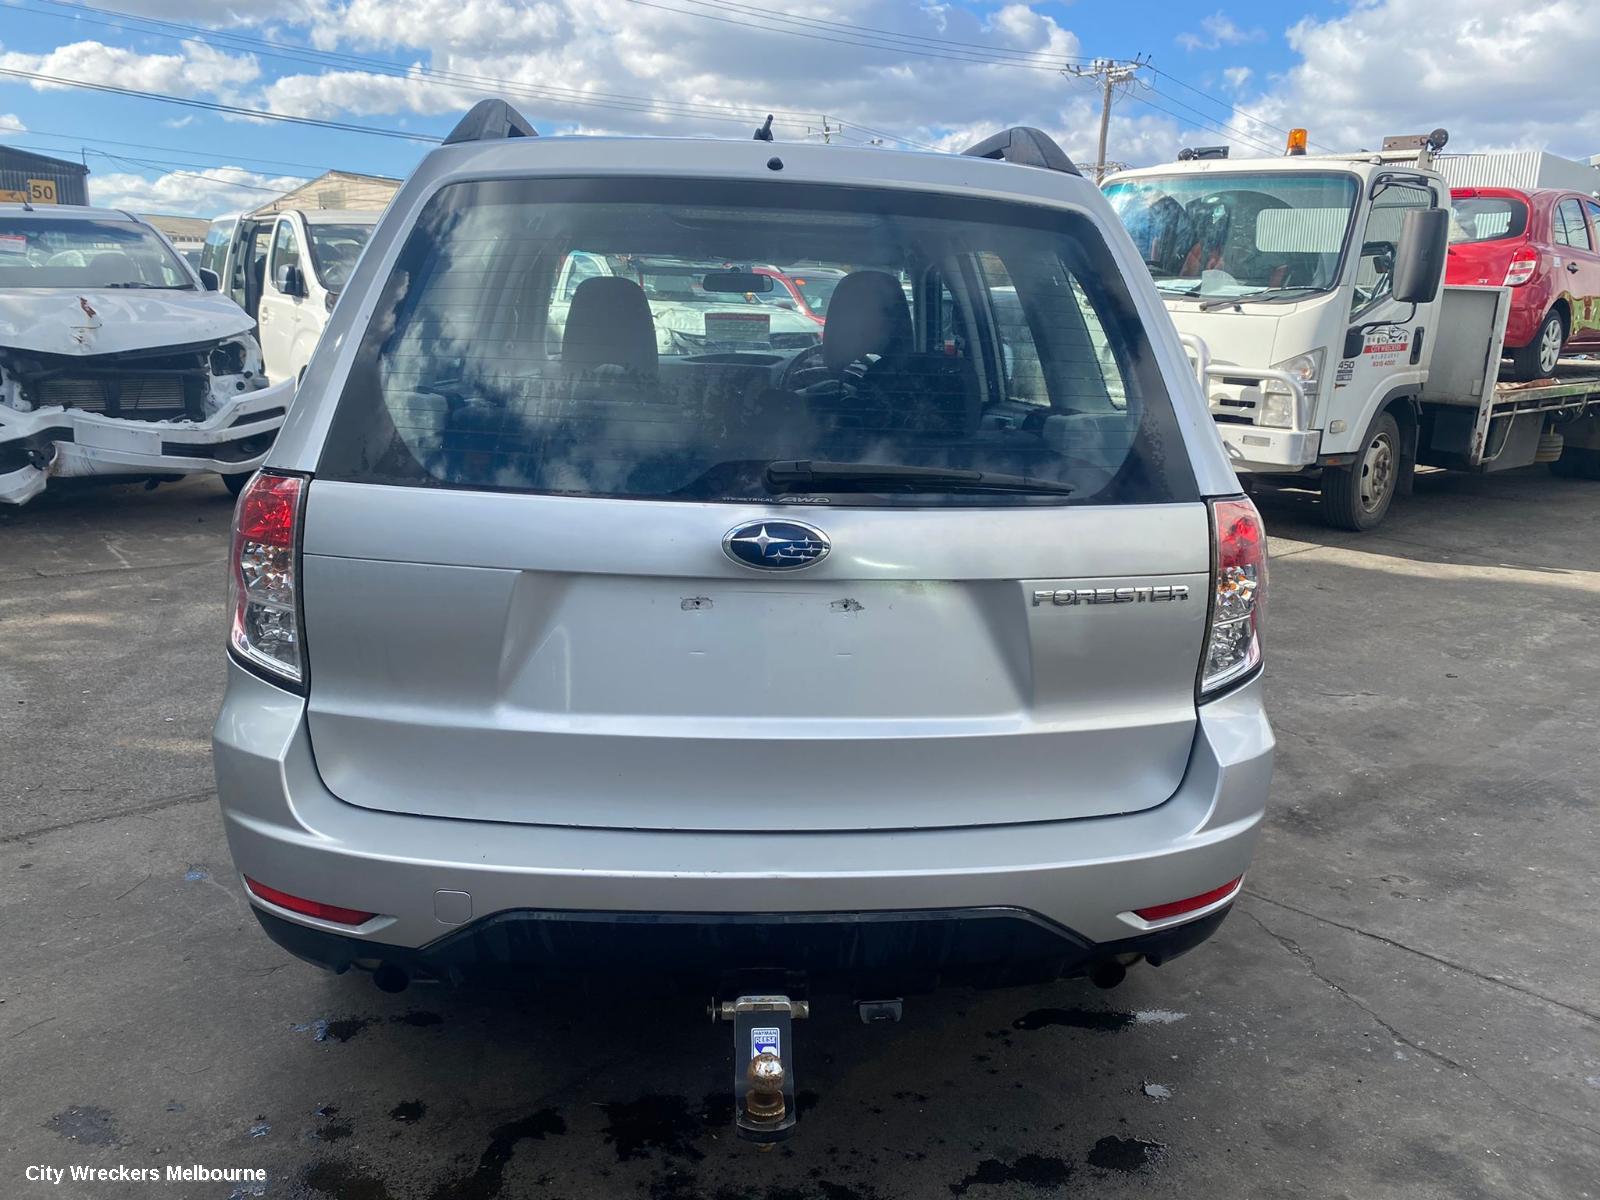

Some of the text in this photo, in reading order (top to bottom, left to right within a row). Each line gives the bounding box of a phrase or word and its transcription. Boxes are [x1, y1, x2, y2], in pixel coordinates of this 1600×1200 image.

[32, 185, 53, 200] 50
[1338, 360, 1355, 369] 450
[1033, 584, 1190, 607] FORESTER
